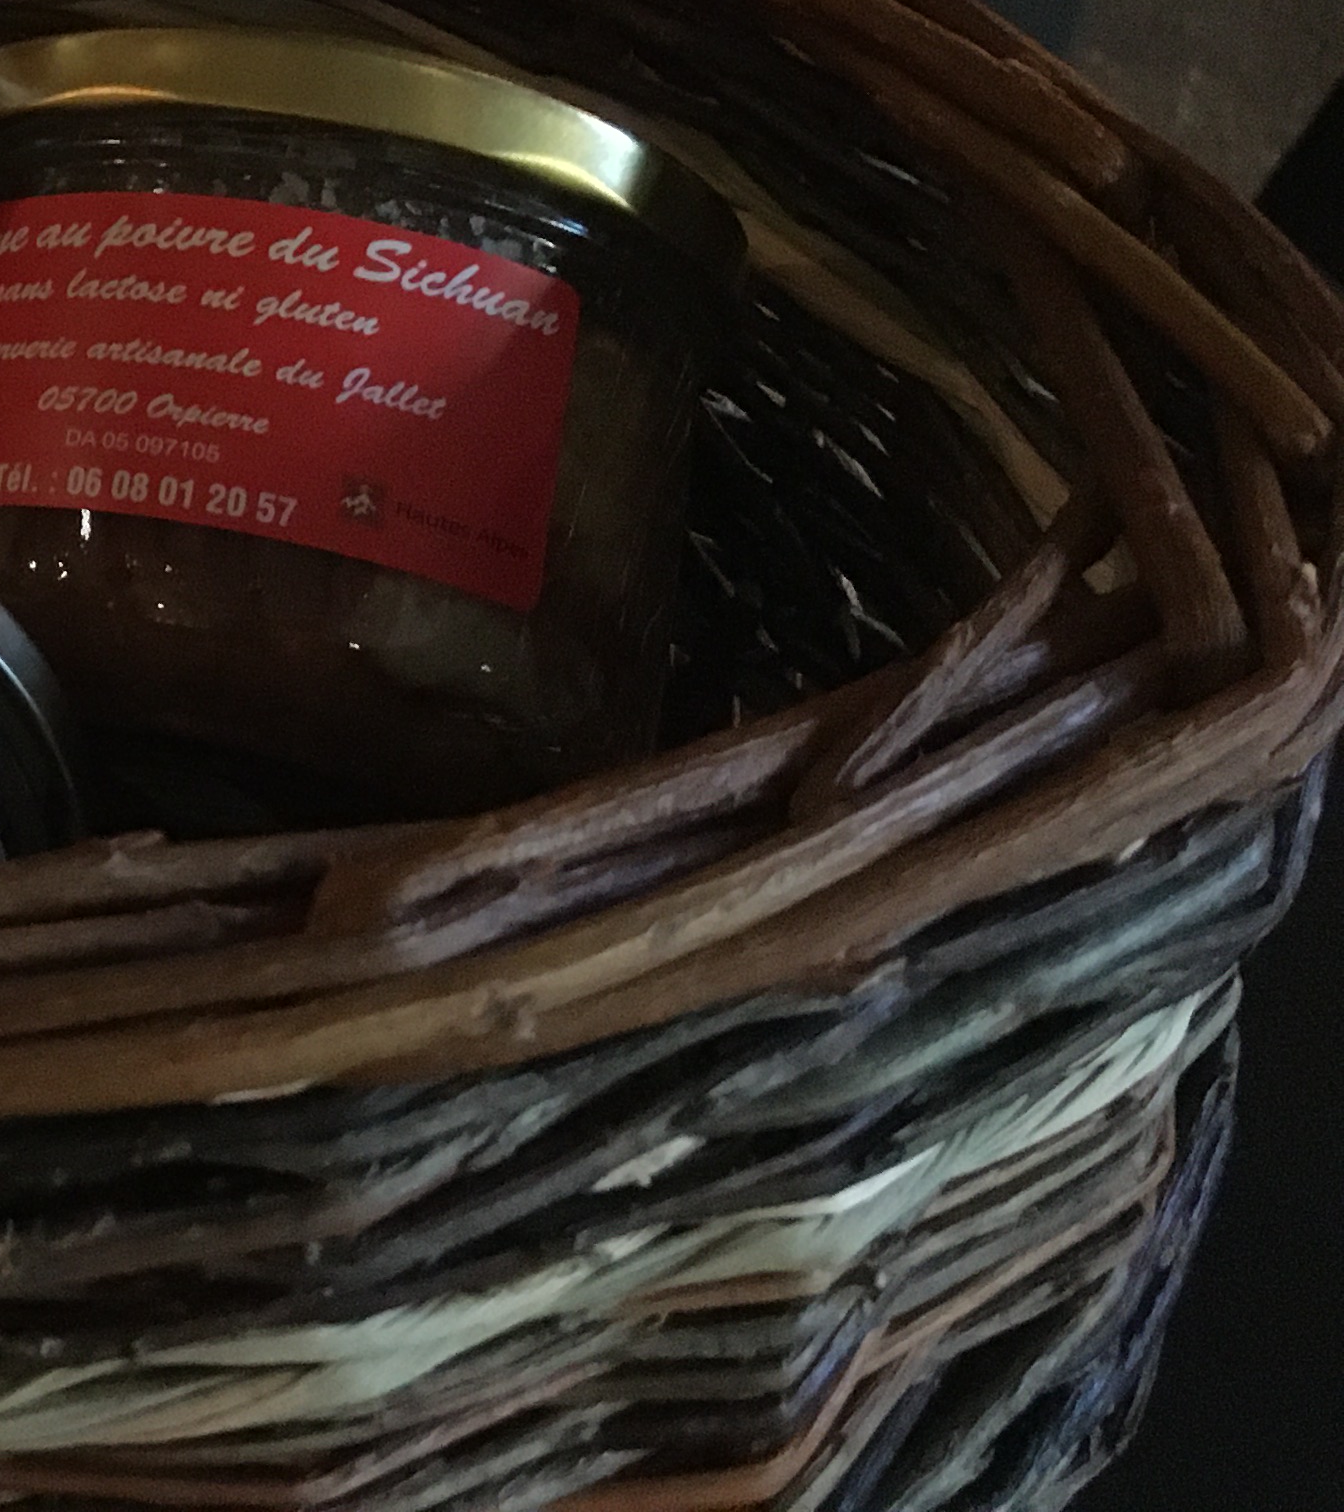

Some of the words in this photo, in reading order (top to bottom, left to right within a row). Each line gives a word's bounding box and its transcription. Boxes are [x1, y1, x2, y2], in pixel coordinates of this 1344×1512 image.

[36, 221, 93, 249] au
[92, 214, 257, 260] poivre
[267, 226, 341, 272] du
[352, 238, 562, 336] Sichuan
[66, 267, 189, 305] lactose
[199, 285, 245, 311] ni
[251, 289, 381, 336] gluten
[37, 385, 139, 414] 05700
[145, 393, 271, 436] Orpierre
[86, 338, 263, 378] artisanale
[274, 357, 326, 389] du
[334, 366, 448, 422] Jallet
[64, 428, 97, 449] DA
[102, 431, 130, 452] 05
[135, 436, 221, 464] 097105
[66, 466, 105, 496] 06
[111, 469, 151, 503] 08
[158, 475, 196, 510] 01
[205, 482, 248, 518] 20
[254, 490, 300, 528] 57
